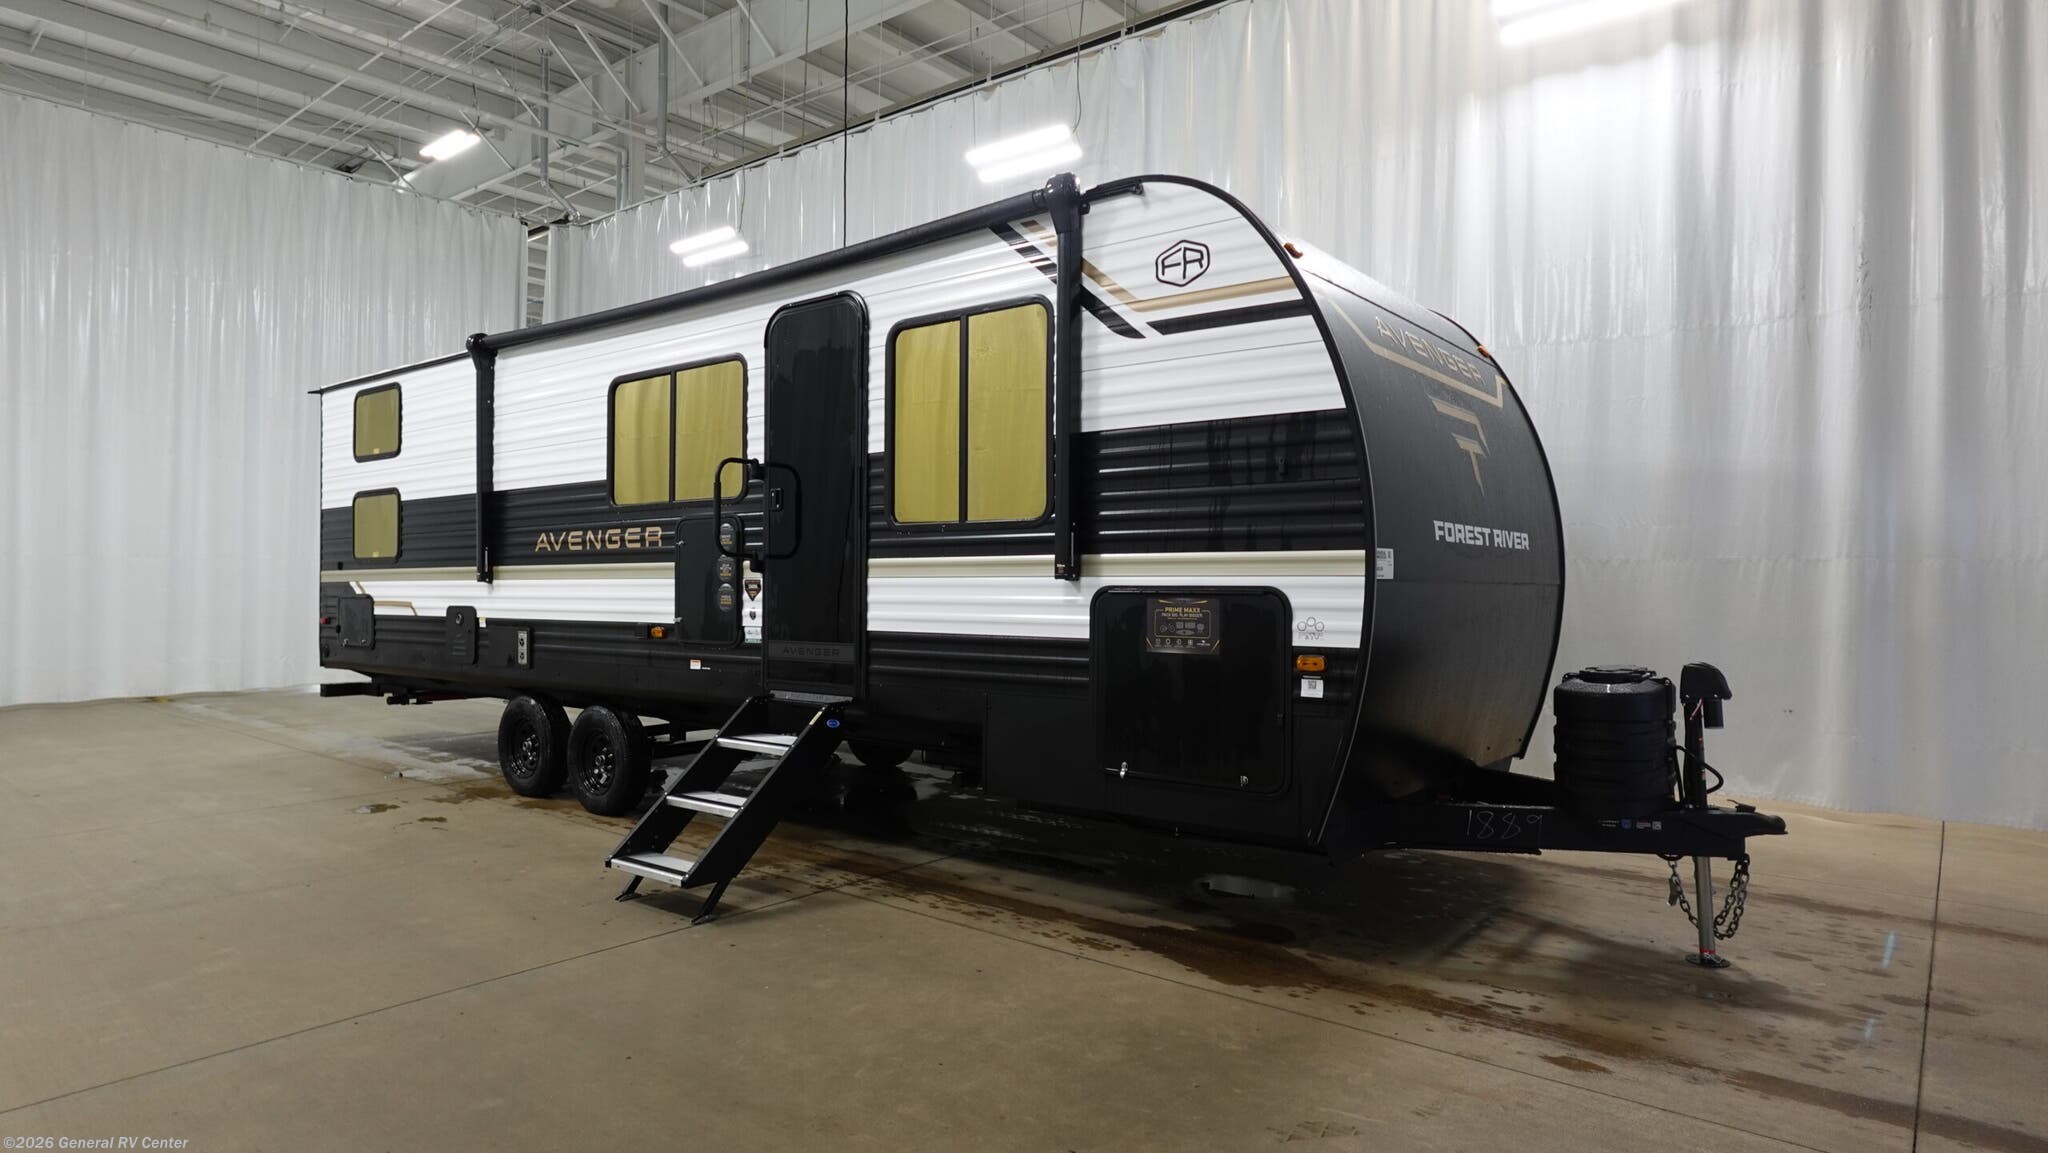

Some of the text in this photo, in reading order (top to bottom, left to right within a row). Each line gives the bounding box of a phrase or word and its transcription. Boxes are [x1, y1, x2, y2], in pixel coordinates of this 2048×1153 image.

[1375, 316, 1487, 386] AVENGER
[534, 526, 662, 553] AVENGER
[1433, 520, 1530, 551] FOREST RIVER
[783, 646, 841, 658] AVENGER
